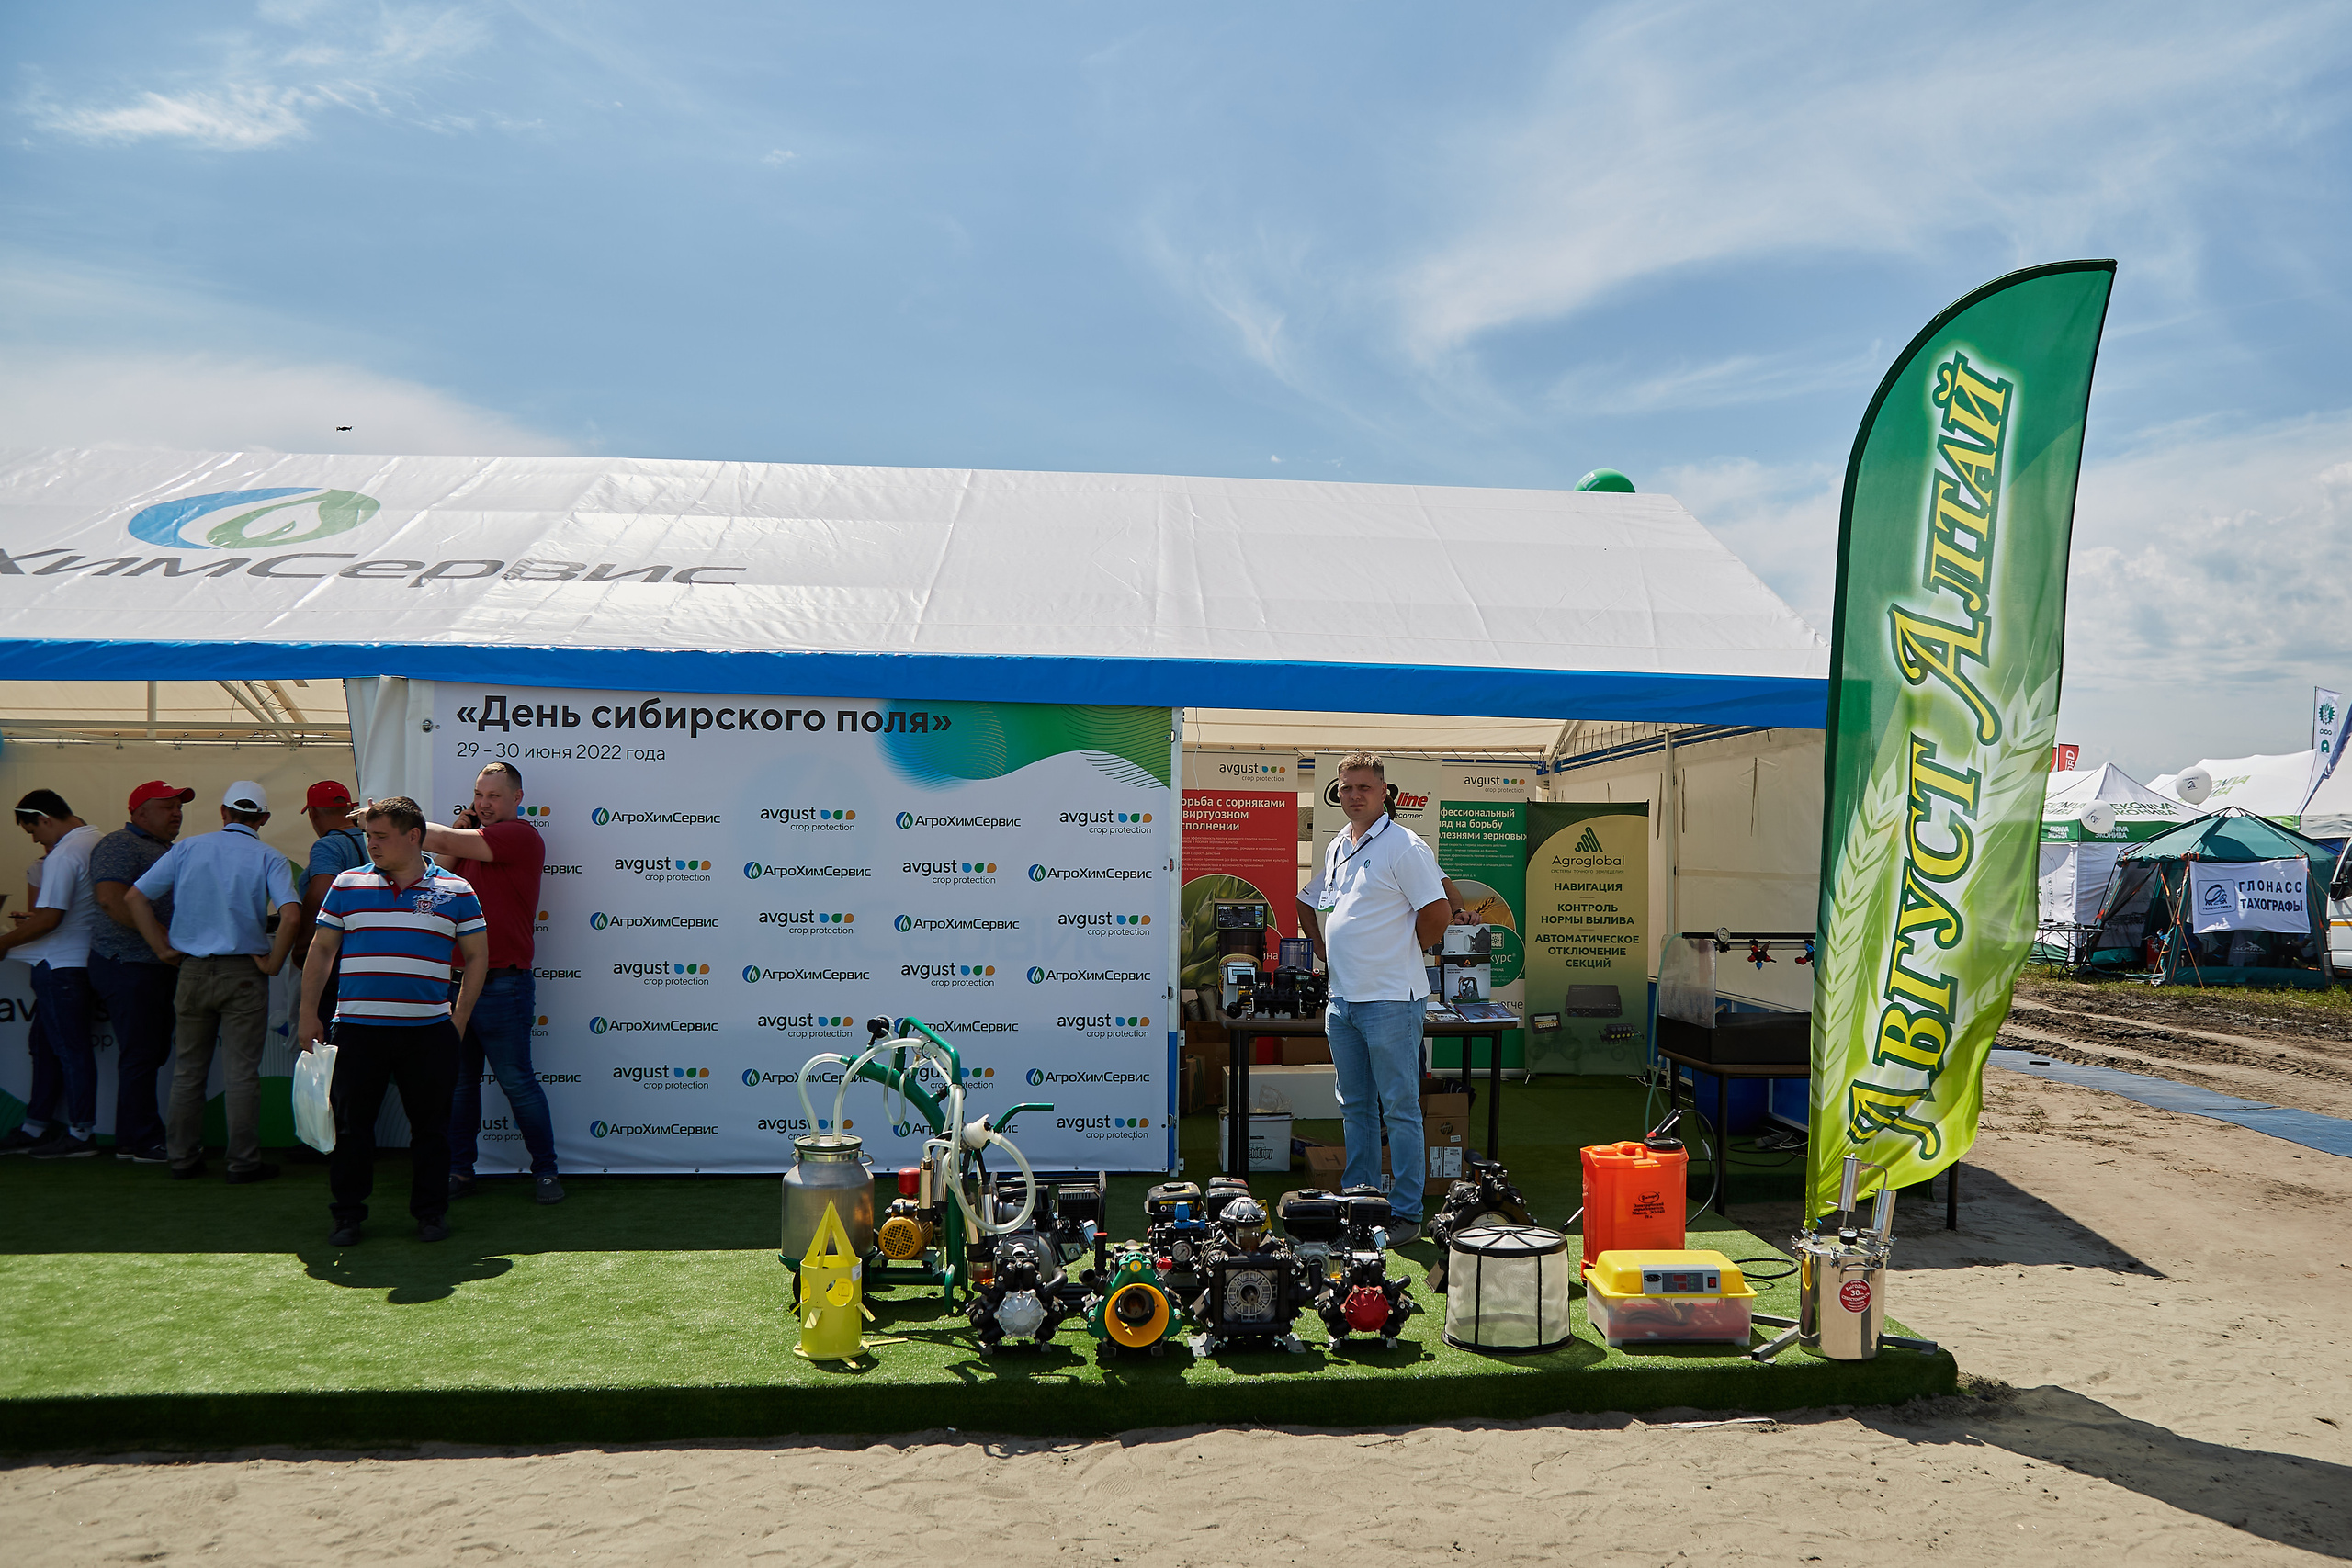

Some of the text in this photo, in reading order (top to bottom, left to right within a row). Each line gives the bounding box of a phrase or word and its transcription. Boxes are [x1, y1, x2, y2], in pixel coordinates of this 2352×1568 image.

[457, 695, 952, 738] «День сибирского поля»
[458, 742, 479, 757] 29
[496, 743, 519, 758] 30
[526, 748, 571, 758] июня
[577, 745, 621, 759] 2022
[627, 750, 664, 761] года
[1220, 763, 1258, 775] avgust
[1464, 776, 1499, 787] avgust
[1182, 796, 1285, 809] орьба с сорняками
[2110, 802, 2177, 810] EKONIVA
[611, 812, 720, 825] АгроХимСервис
[761, 807, 816, 823] avgust
[1060, 810, 1114, 826] avgust
[1183, 810, 1249, 820] виртуозном
[1441, 807, 1514, 818] фессиональный
[812, 824, 854, 832] protection
[915, 816, 1021, 829] АгроХимСервис
[1182, 822, 1239, 831] сполнении
[1470, 819, 1503, 830] борьбу
[1110, 827, 1151, 835] protection
[1483, 833, 1527, 841] зерновых
[615, 857, 671, 874] avgust
[1552, 855, 1624, 868] Agroglobal
[763, 865, 871, 878] АгроХимСервис
[903, 860, 956, 876] avgust
[1047, 868, 1151, 880] АгроХимСервис
[667, 874, 710, 882] protection
[954, 876, 995, 885] protection
[1555, 883, 1623, 893] НАВИГАЦИЯ
[2239, 880, 2302, 893] ГЛОНАСС
[1558, 904, 1618, 912] КОНТРОЛЬ
[2240, 898, 2302, 911] ТАХОГРАФЫ
[610, 916, 718, 929] АгроХимСервис
[759, 910, 814, 927] avgust
[1058, 912, 1112, 929] avgust
[1542, 916, 1583, 924] НОРМЫ
[810, 927, 853, 935] protection
[913, 919, 1019, 931] АгроХимСервис
[1108, 929, 1149, 937] protection
[1535, 934, 1639, 943] АВТОМАТИЧЕСКОЕ
[1548, 947, 1626, 956] ОТКЛЮЧЕНИЕ
[614, 961, 669, 977] avgust
[1566, 958, 1611, 969] СЕКЦИЙ
[763, 969, 869, 982] АгроХимСервис
[901, 963, 956, 979] avgust
[1046, 970, 1150, 982] АгроХимСервис
[666, 978, 708, 987] protection
[952, 979, 994, 987] protection
[609, 1021, 718, 1032] АгроХимСервис
[758, 1013, 813, 1031] avgust
[1057, 1014, 1111, 1031] avgust
[809, 1031, 852, 1039] protection
[1107, 1030, 1148, 1039] protection
[614, 1065, 669, 1082] avgust
[1046, 1072, 1149, 1084] АгроХимСервис
[665, 1082, 708, 1090] protection
[1057, 1115, 1110, 1132] avgust
[610, 1124, 718, 1136] АгроХимСервис
[1107, 1132, 1148, 1140] protection
[482, 1134, 503, 1142] crop
